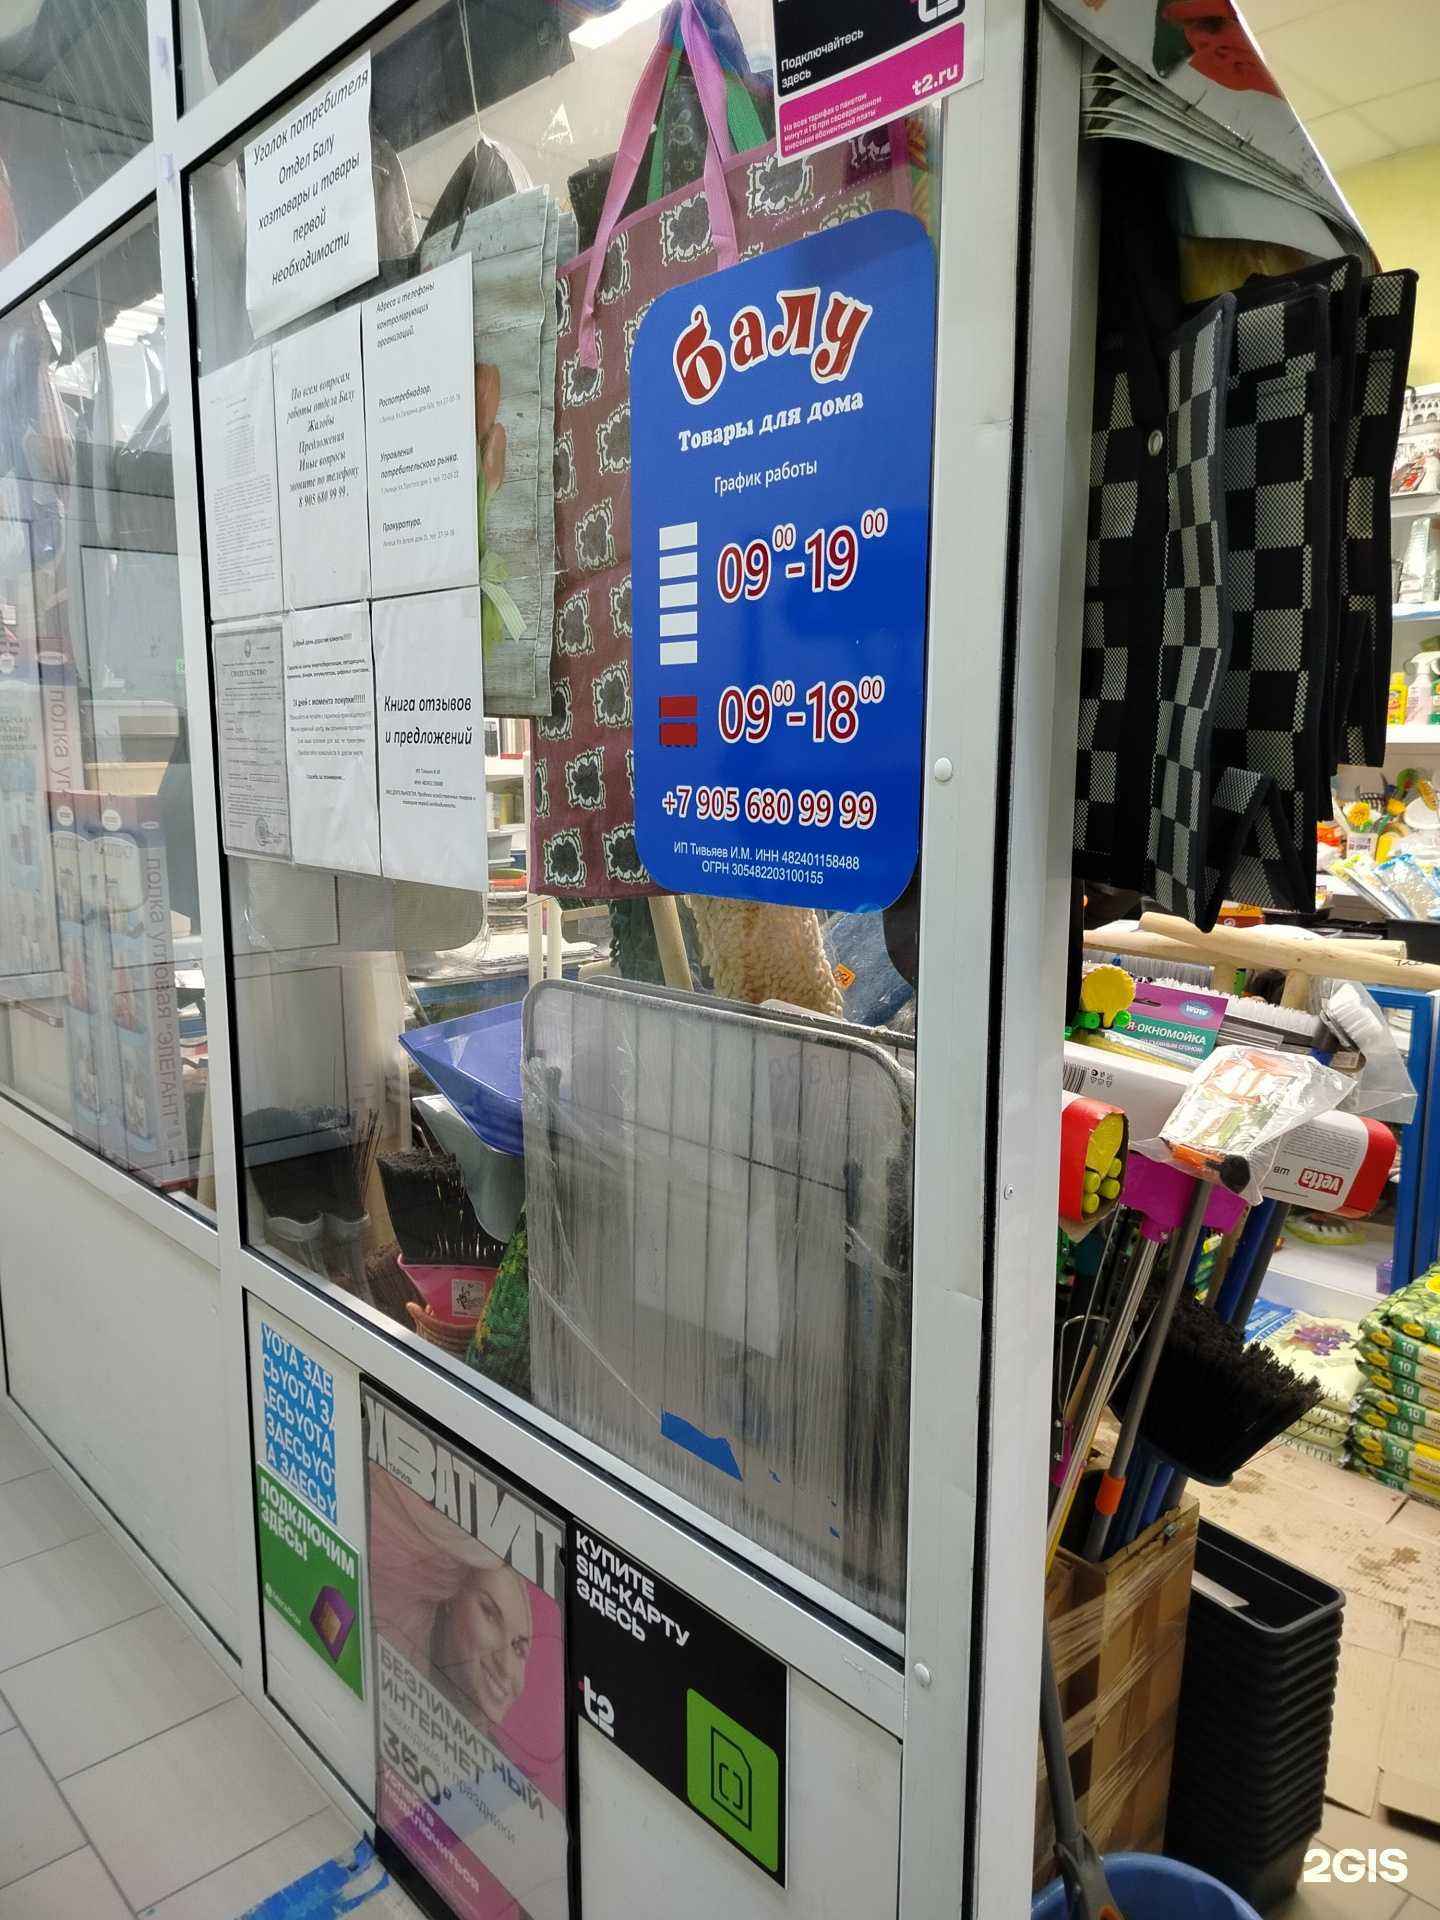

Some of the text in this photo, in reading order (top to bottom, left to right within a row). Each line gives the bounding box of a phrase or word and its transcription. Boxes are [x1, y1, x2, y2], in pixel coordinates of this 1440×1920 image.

[781, 28, 864, 73] Подключайтесь
[781, 68, 812, 89] здесь
[911, 63, 958, 96] t2.ru
[253, 69, 368, 167] Уголок потребителя
[278, 133, 336, 185] Отдел Балу
[258, 152, 360, 231] хозтовары и товары
[293, 208, 327, 243] первой
[272, 231, 350, 286] необходимости
[401, 282, 435, 302] телефоны
[678, 392, 864, 452] Товары для дома
[714, 458, 817, 497] График работы
[384, 696, 472, 712] Книга отзывов
[385, 727, 472, 747] и предложений
[662, 785, 877, 830] +7 905 680 99 99
[673, 841, 860, 872] ИП Тивьяев И.М. ИНН 482401158488
[702, 860, 824, 885] ОГРН 305482203100155
[147, 857, 164, 921] полка
[261, 1476, 354, 1580] ПОДКЛЮЧИМ
[576, 1530, 655, 1602] КУПИТЕ
[576, 1554, 690, 1647] SIM-КАРТУ
[576, 1577, 646, 1642] ЗДЕСЬ
[382, 1680, 484, 1785] ИНТЕРНЕТ
[584, 1675, 615, 1738] t2
[381, 1651, 544, 1822] БЕЗЛИМИТНЫЙ
